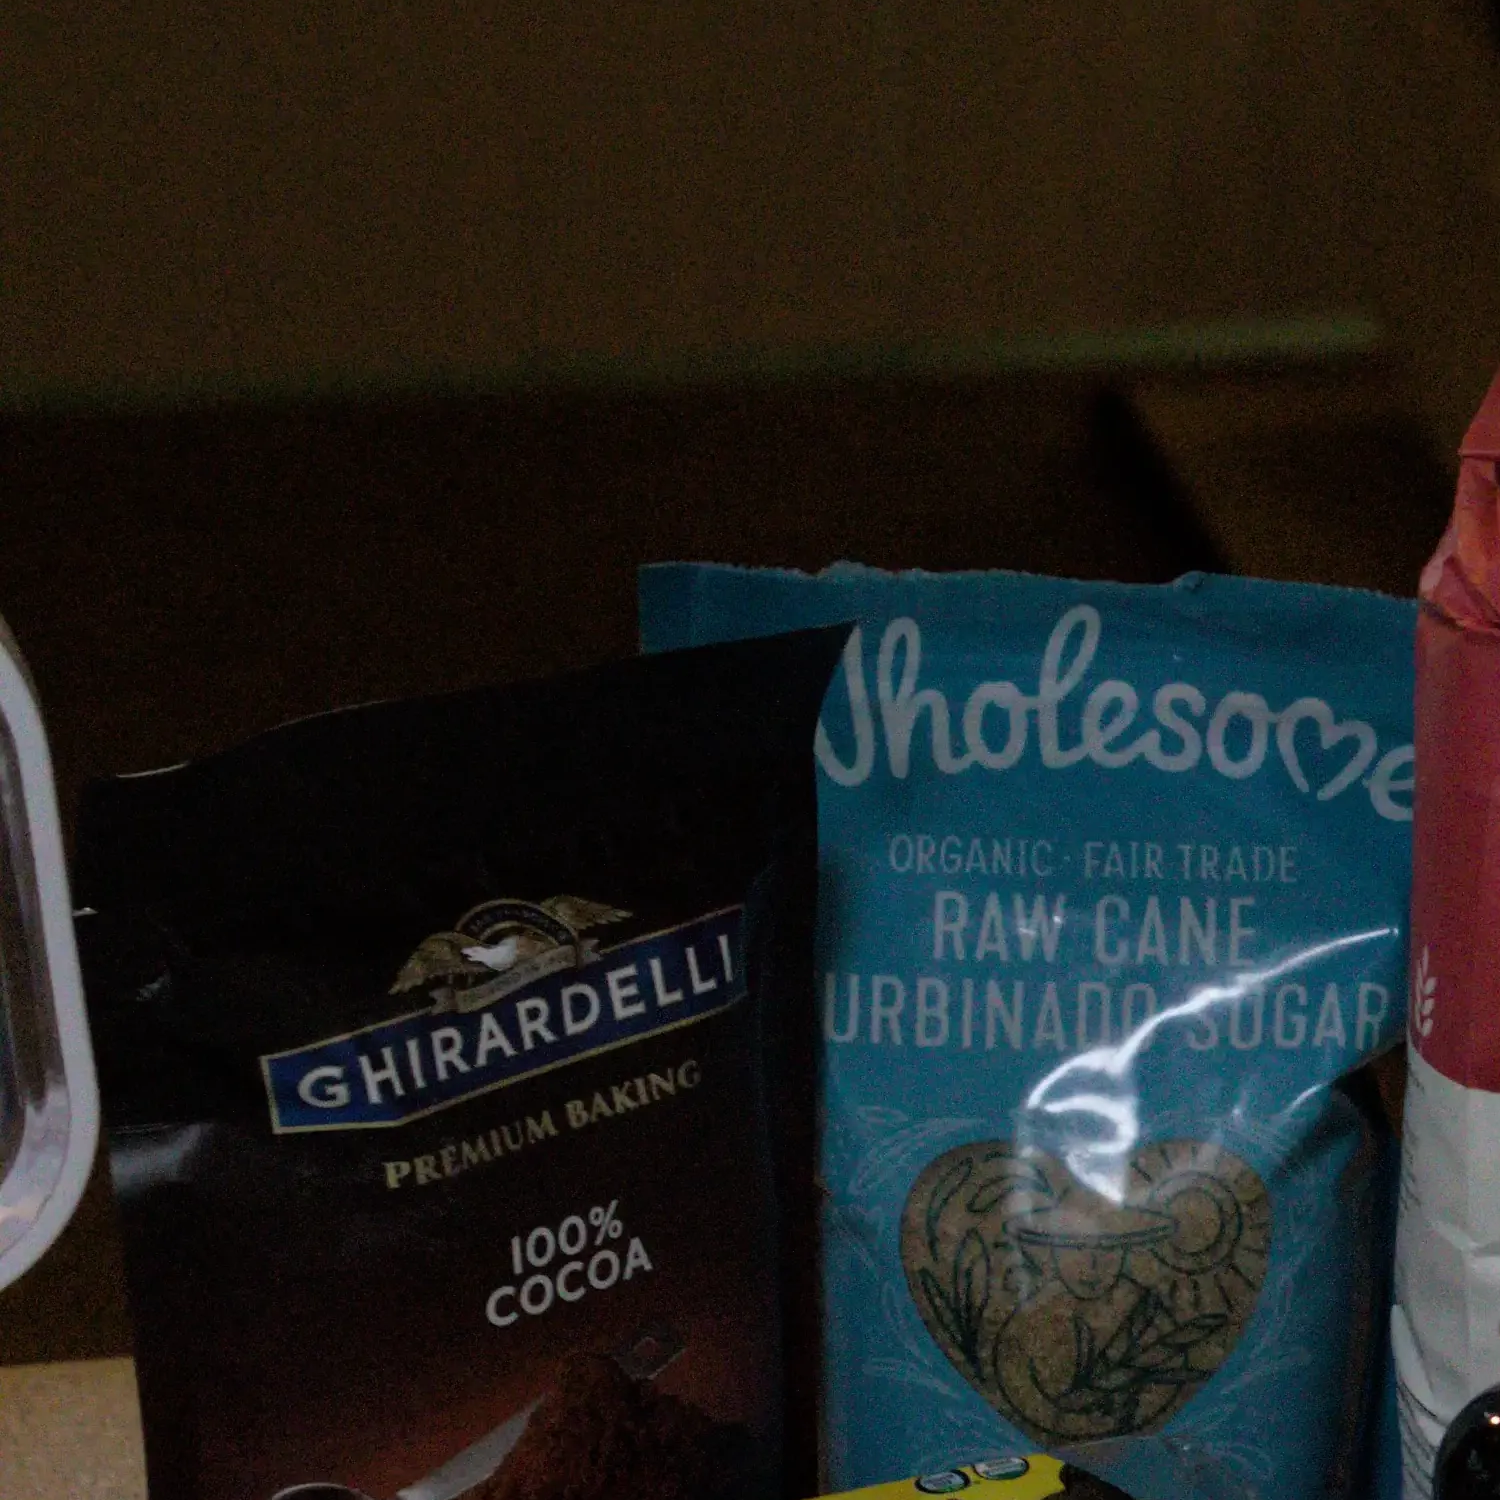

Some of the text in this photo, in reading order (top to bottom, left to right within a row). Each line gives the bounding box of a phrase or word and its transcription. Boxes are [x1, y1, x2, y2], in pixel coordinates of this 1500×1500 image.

[888, 832, 1299, 884] ORGANIC FAIR TRADE
[933, 890, 1257, 967] RAW CANE
[296, 933, 736, 1109] GHIRARDELLI
[822, 970, 1391, 1053] URBINADO SUGAR
[382, 1059, 701, 1191] PREMIUM BAKING
[509, 1199, 625, 1277] 100%
[485, 1235, 655, 1328] COCOA
